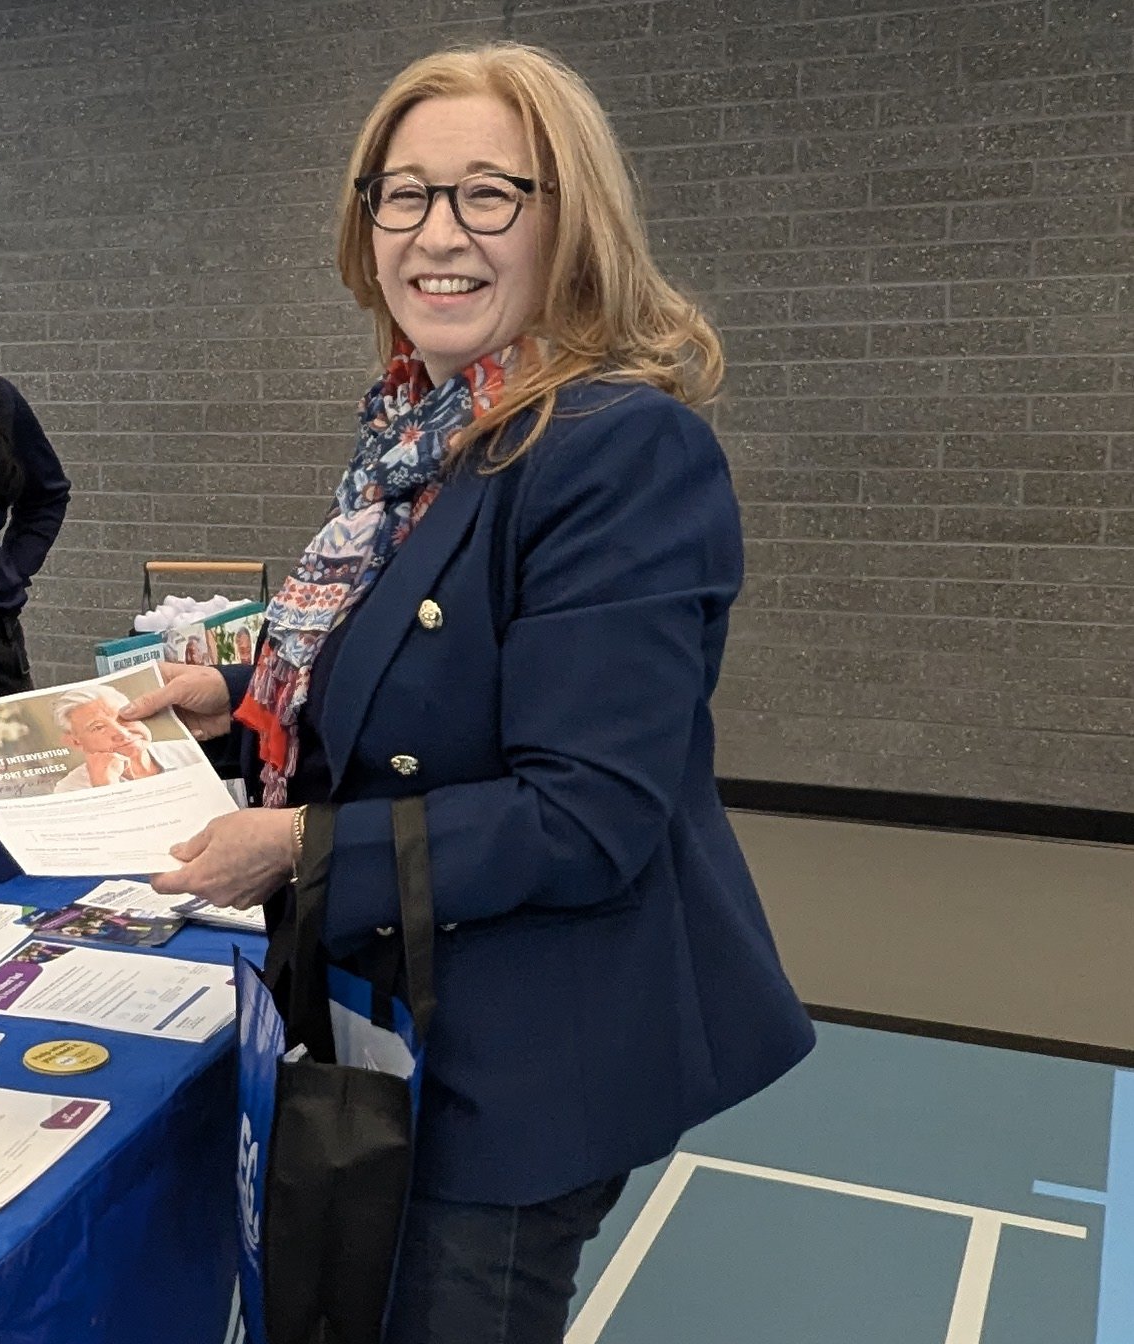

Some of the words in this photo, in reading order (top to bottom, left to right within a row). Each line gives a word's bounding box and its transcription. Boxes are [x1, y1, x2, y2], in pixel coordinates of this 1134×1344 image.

[132, 652, 150, 666] SMILES
[6, 747, 70, 765] INTERVENTION
[22, 763, 68, 778] SERVICES
